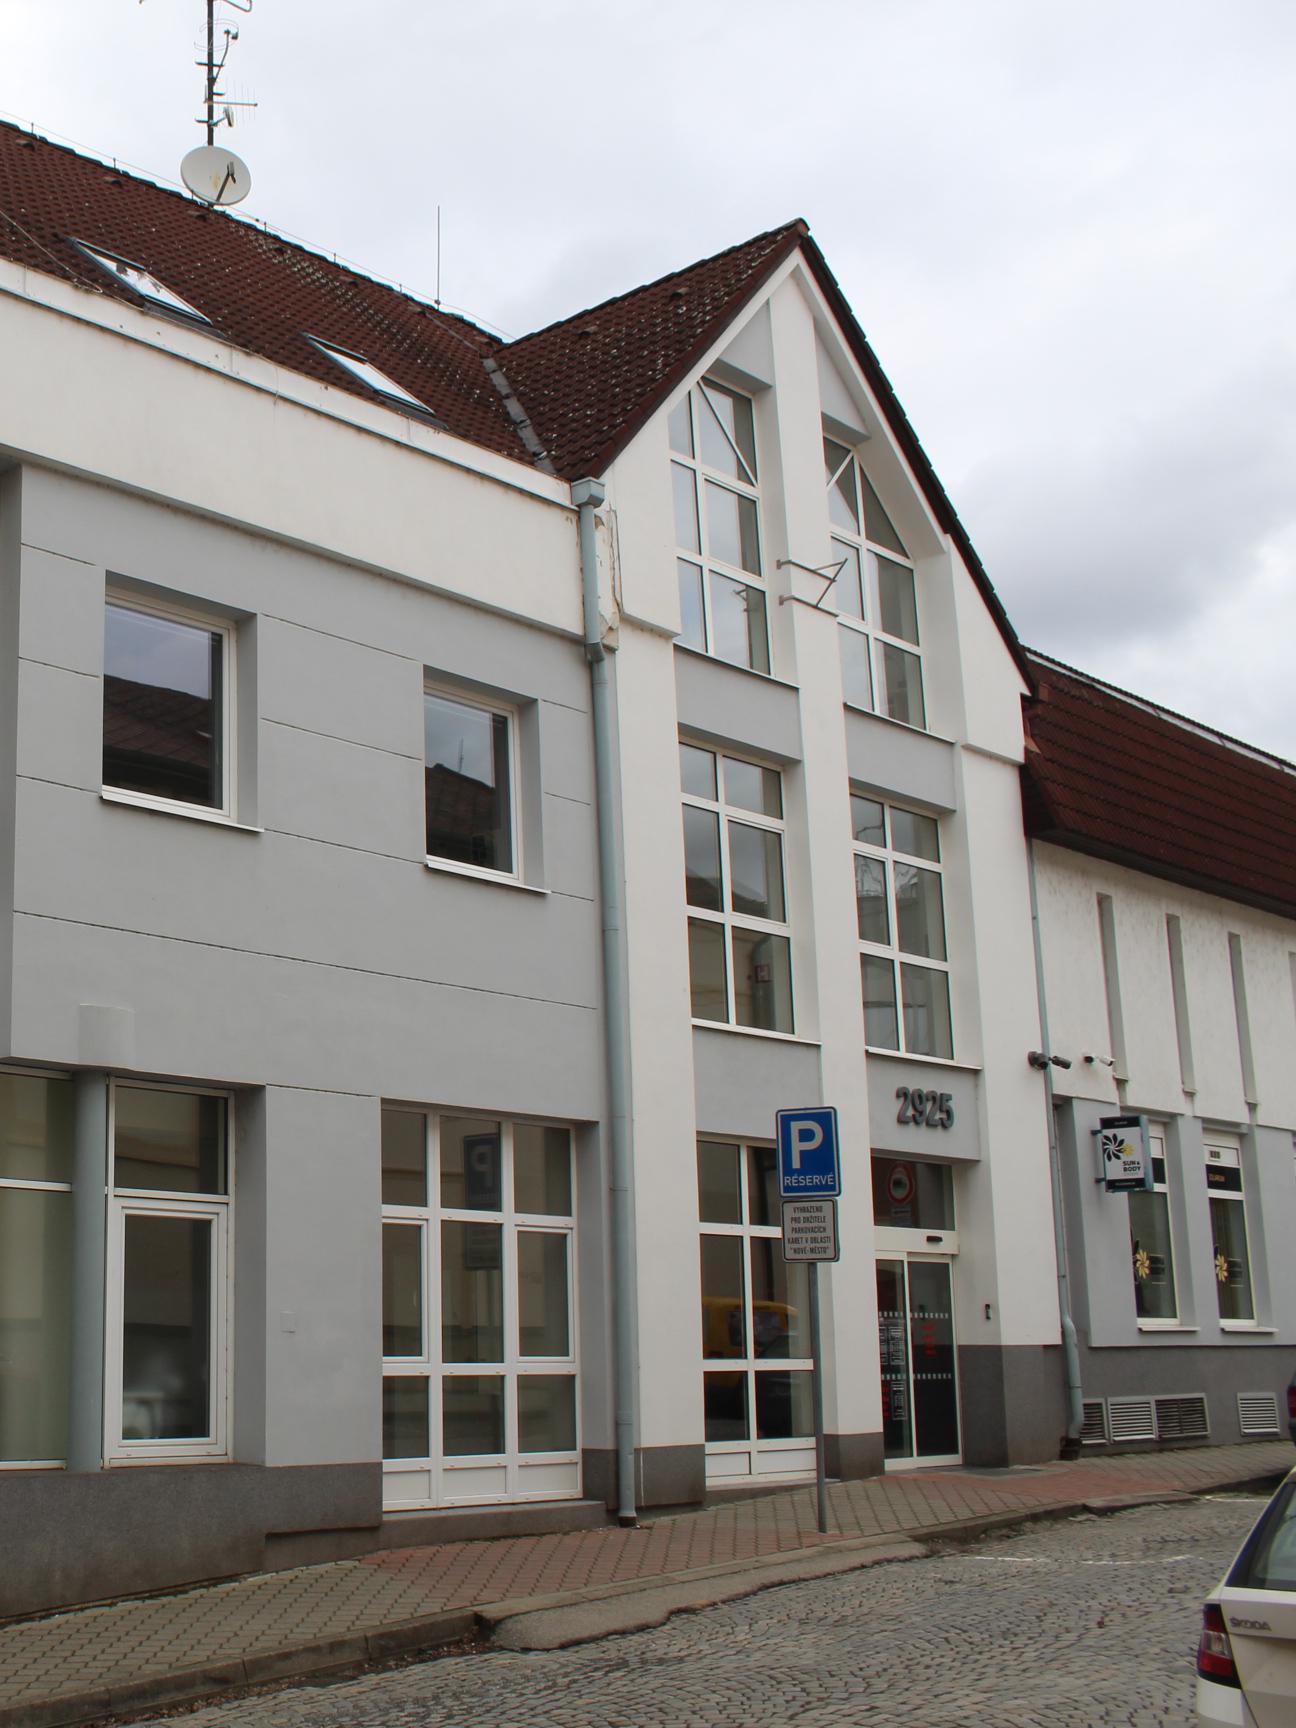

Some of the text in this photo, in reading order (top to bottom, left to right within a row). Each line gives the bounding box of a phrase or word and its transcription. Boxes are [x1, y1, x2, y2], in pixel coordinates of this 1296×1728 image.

[895, 1086, 954, 1128] 2925
[790, 1120, 824, 1169] P
[784, 1172, 835, 1186] RÉSERVÉ
